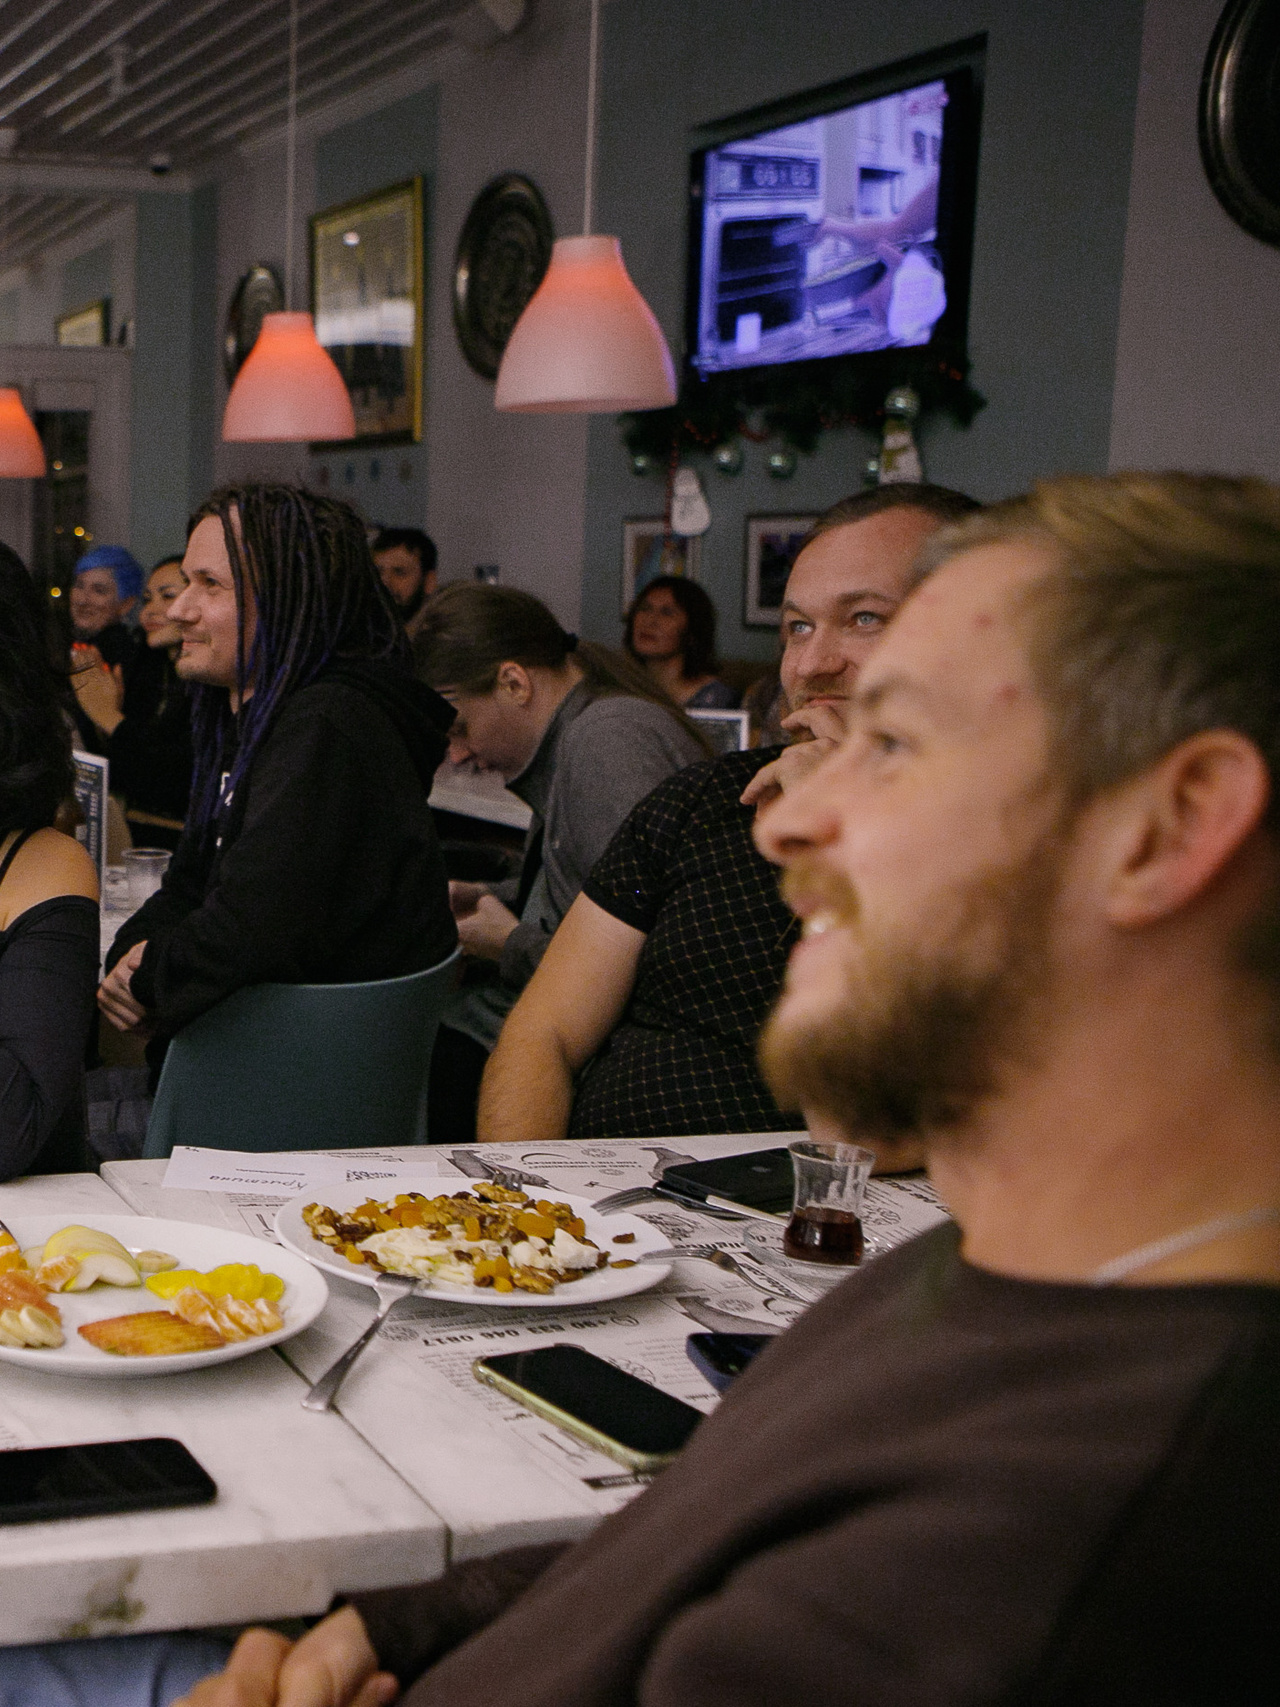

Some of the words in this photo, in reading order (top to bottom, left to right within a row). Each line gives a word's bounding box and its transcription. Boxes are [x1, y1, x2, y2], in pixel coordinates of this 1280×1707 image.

[209, 1175, 308, 1191] Кристина
[479, 1329, 520, 1340] 046
[526, 1323, 566, 1335] 533
[421, 1335, 474, 1347] 0817
